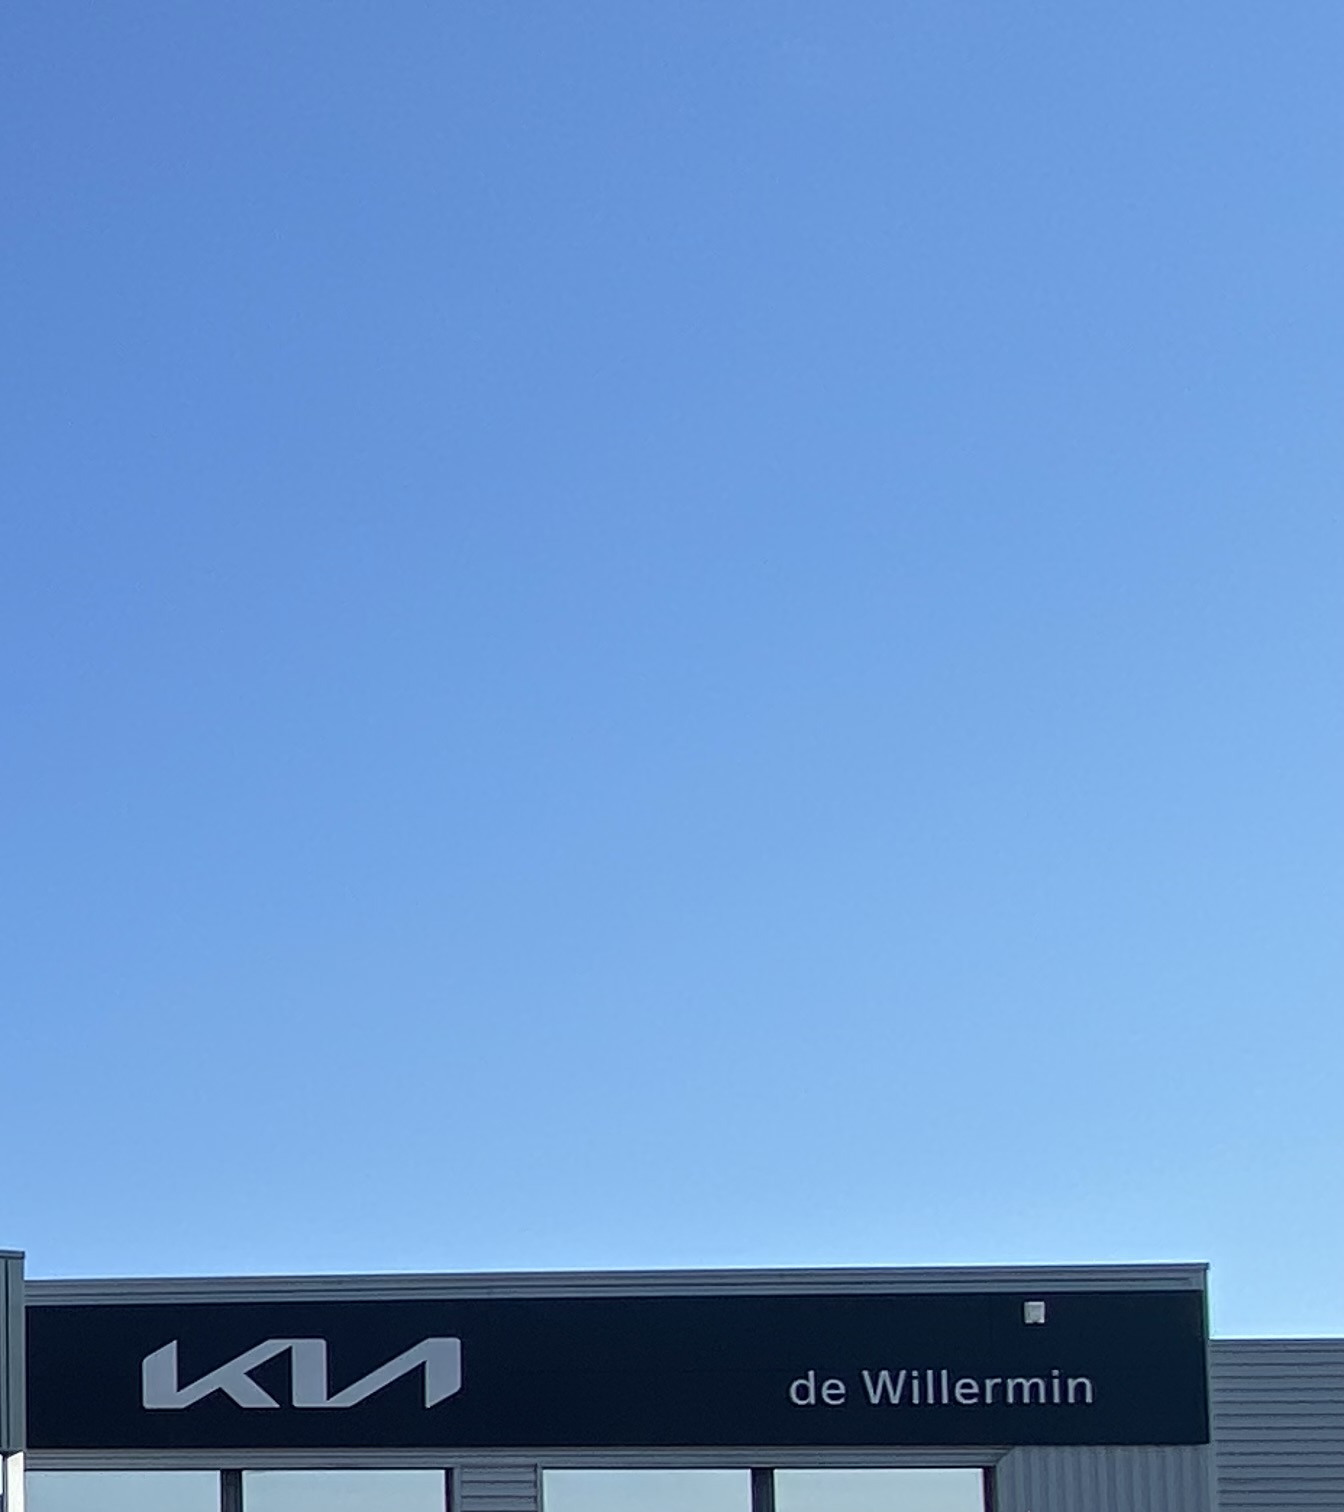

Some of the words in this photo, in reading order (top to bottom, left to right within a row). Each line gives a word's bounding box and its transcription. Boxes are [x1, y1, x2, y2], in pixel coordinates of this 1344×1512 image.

[142, 1337, 462, 1410] KIA
[789, 1370, 847, 1405] de
[861, 1369, 1094, 1405] Willermin
